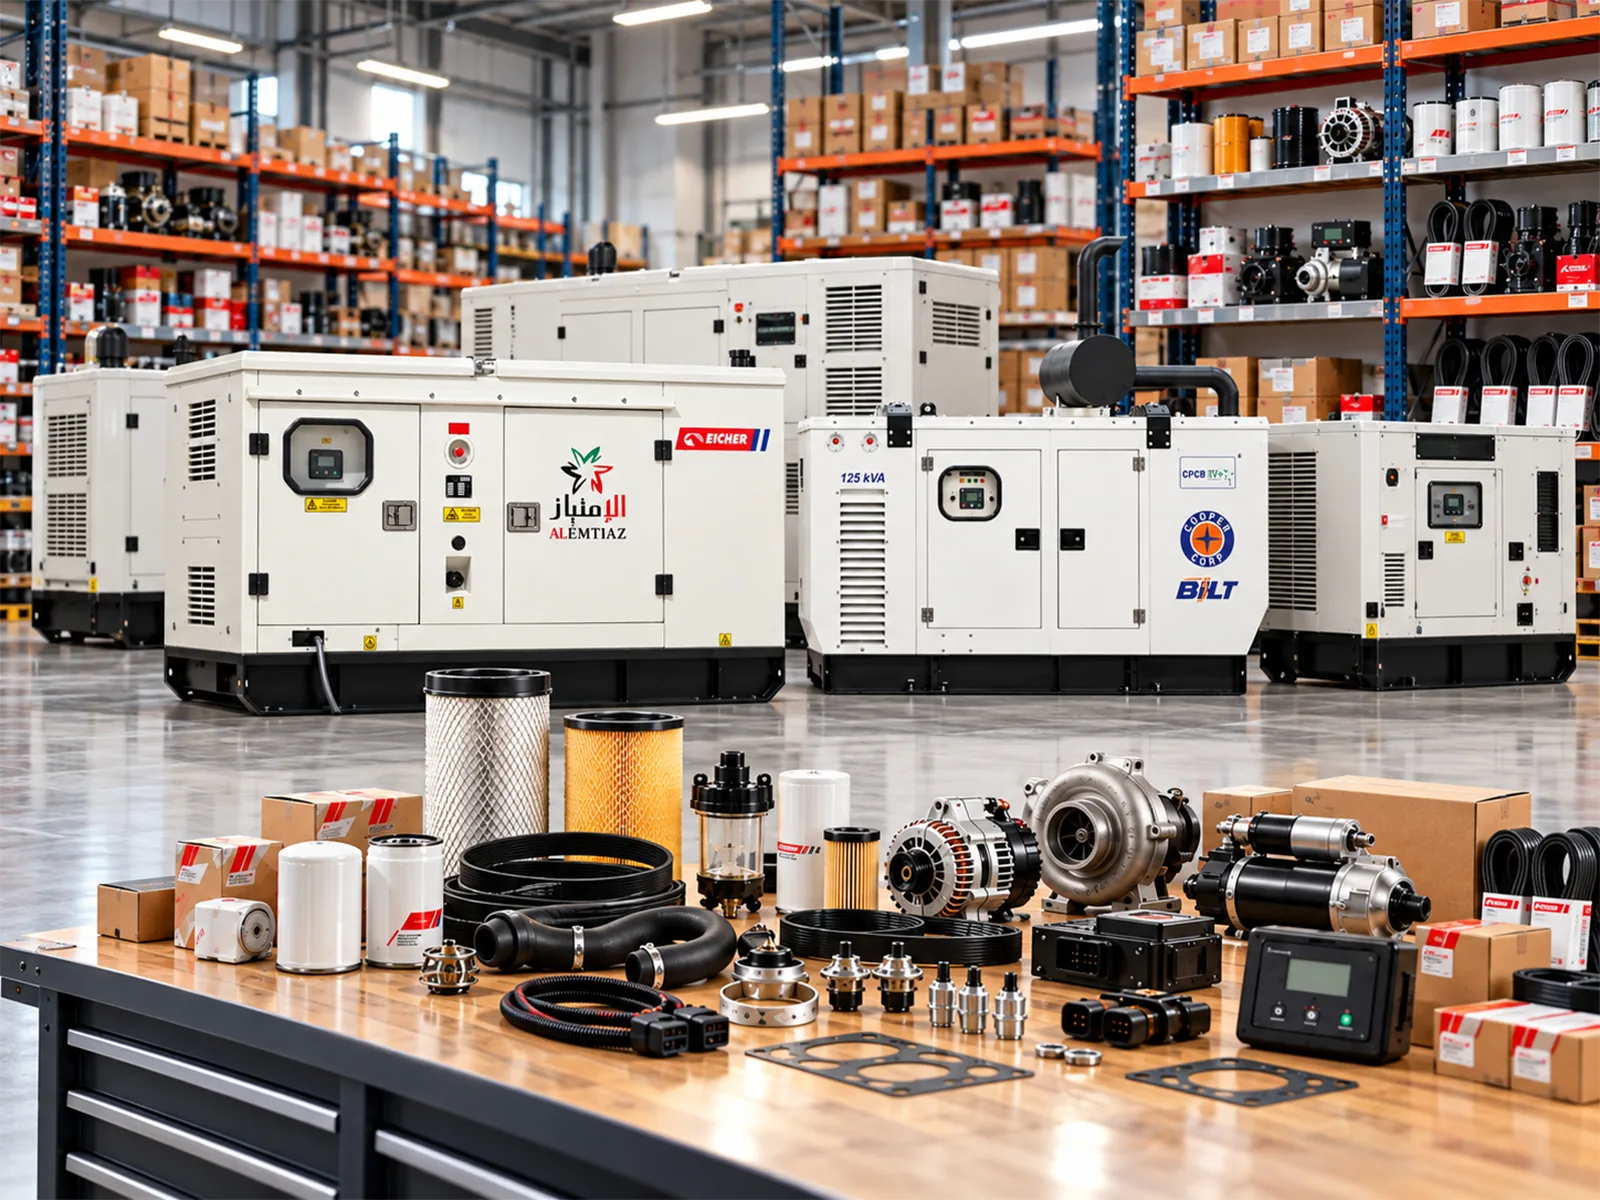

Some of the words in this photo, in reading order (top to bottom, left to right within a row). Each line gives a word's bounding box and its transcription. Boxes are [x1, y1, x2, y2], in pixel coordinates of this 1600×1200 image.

[705, 432, 748, 445] EICHER
[841, 472, 861, 483] 125
[863, 472, 885, 483] kVA
[1182, 469, 1206, 479] CPCB
[549, 527, 627, 540] ALEMTIAZ
[1190, 553, 1223, 566] CORP
